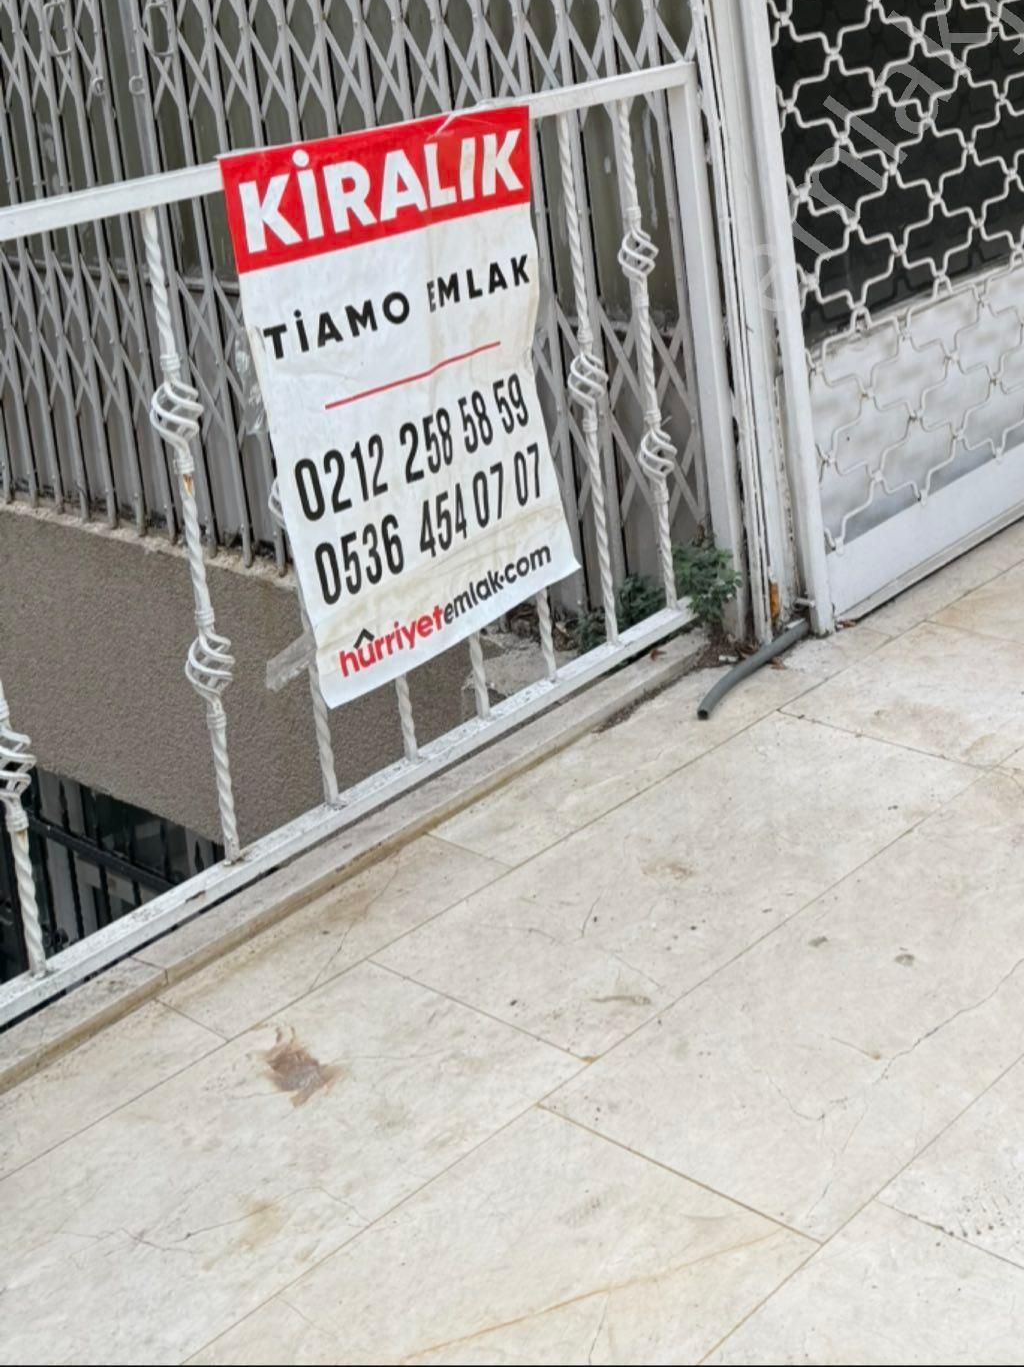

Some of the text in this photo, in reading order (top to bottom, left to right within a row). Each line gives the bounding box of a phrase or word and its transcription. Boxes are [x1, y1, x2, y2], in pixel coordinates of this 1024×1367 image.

[238, 128, 524, 254] KİRALIK
[263, 254, 530, 360] TİAMO EMLAK
[294, 373, 529, 522] 0212 258 58 59
[314, 442, 541, 606] 0536 454 07 07
